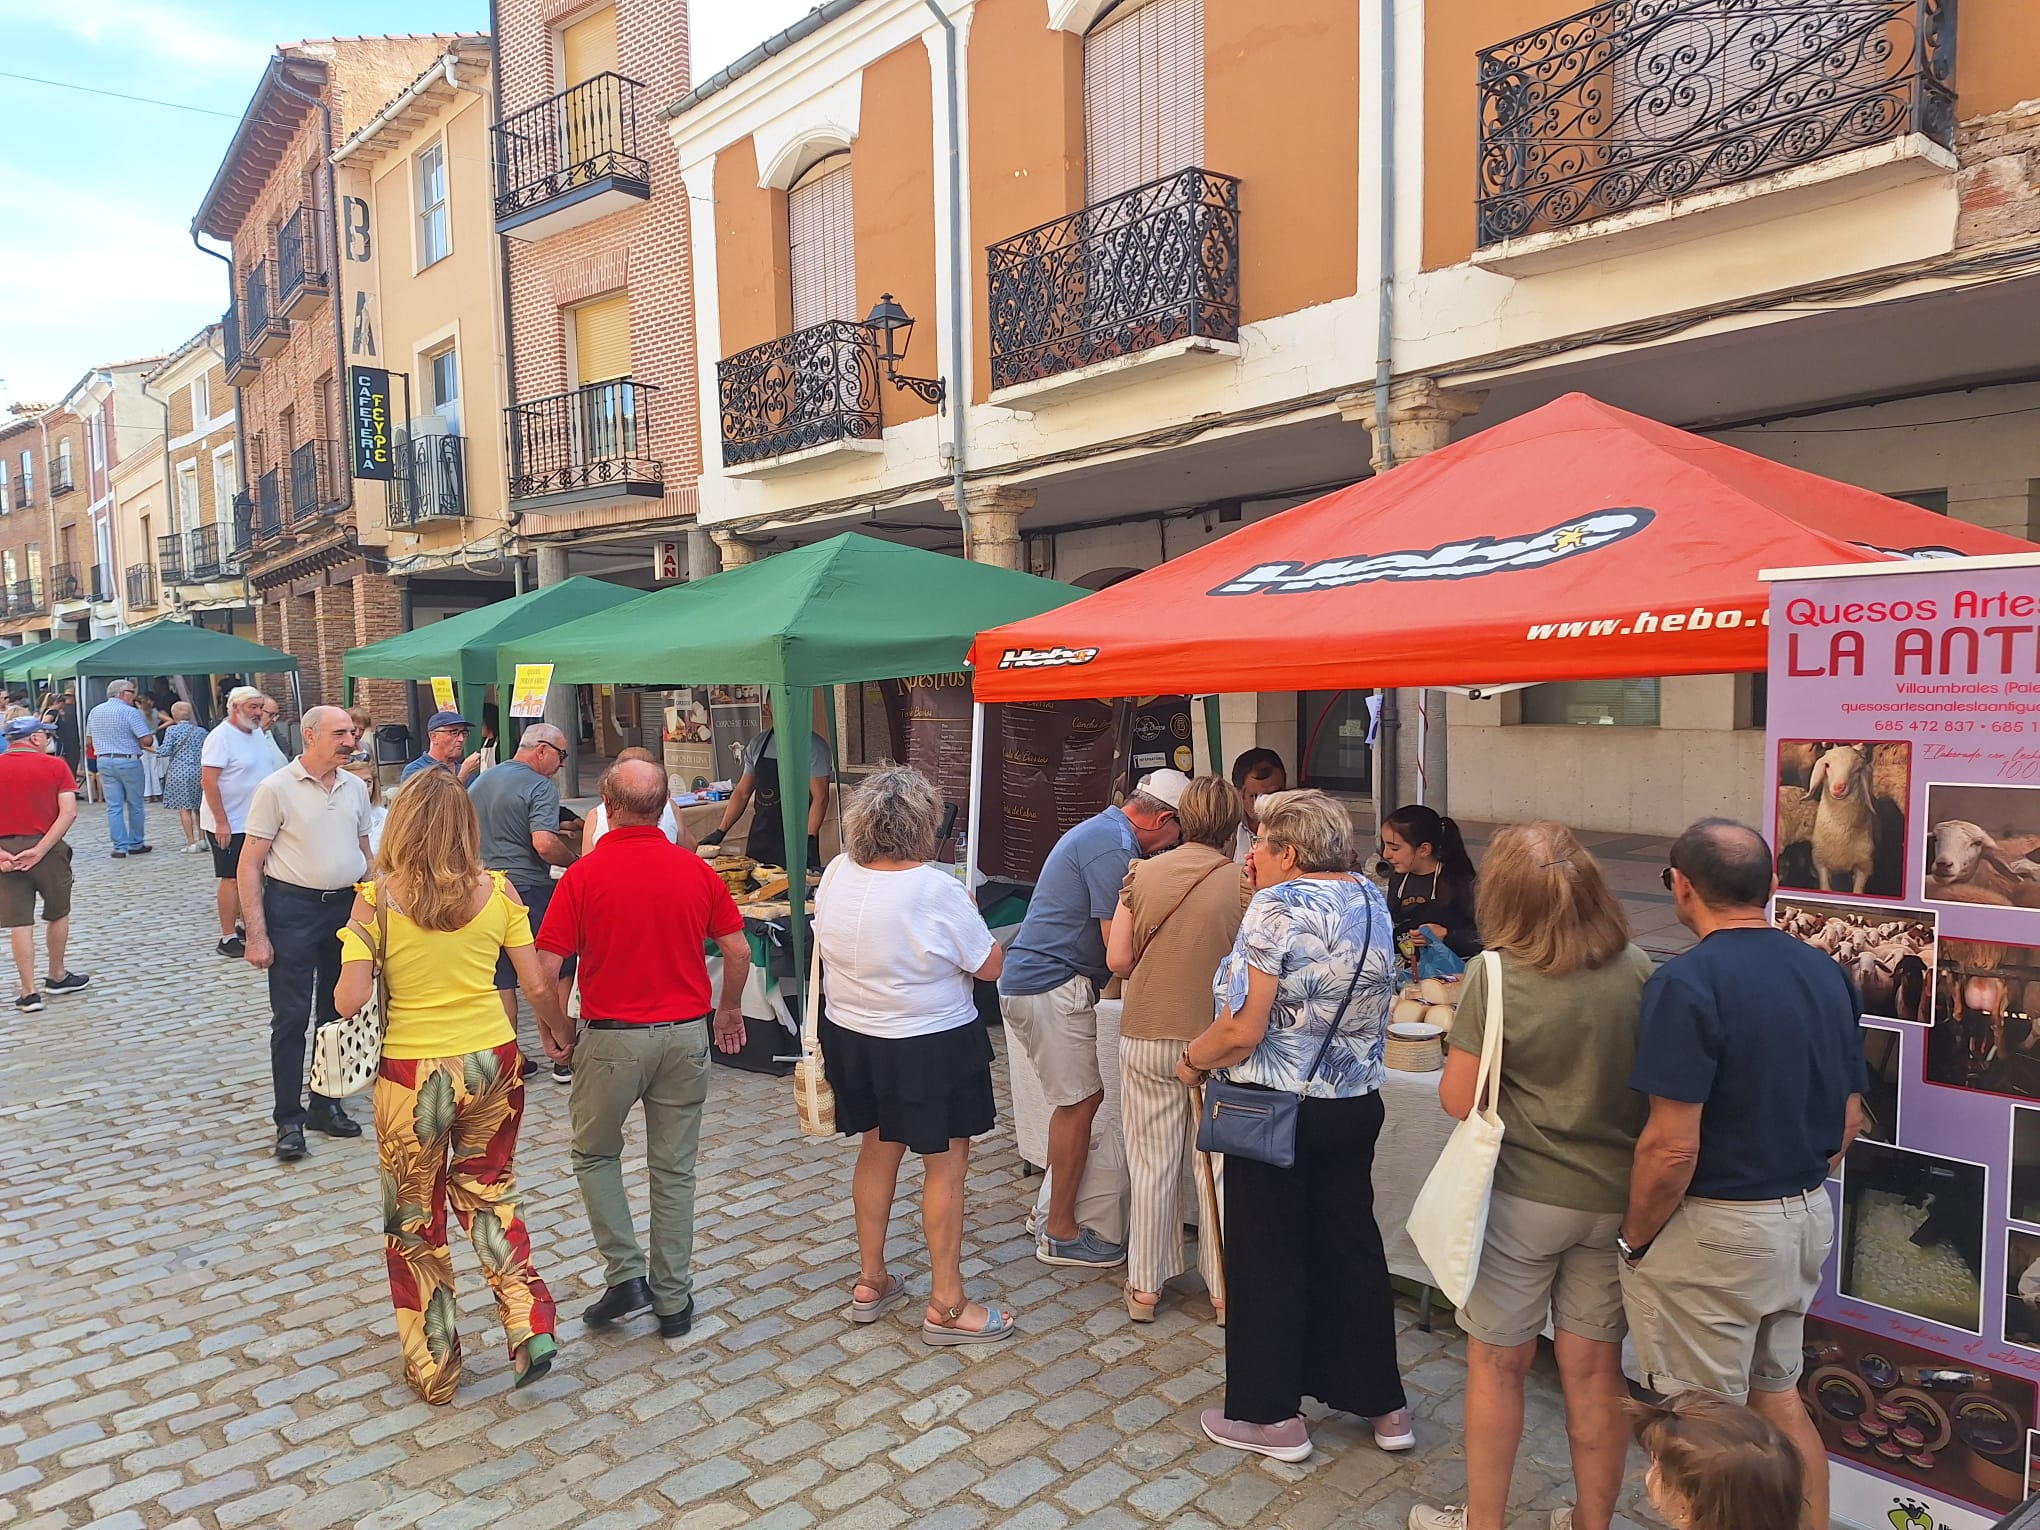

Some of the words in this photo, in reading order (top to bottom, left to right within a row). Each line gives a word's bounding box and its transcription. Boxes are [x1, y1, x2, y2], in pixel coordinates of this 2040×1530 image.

[358, 375, 375, 470] CAFETERIA
[664, 543, 676, 577] PAN
[1786, 598, 1937, 627] Quesos
[998, 647, 1099, 669] Hebo
[1788, 631, 1864, 677] LA
[1896, 682, 1999, 694] Villaumbrales
[1874, 720, 1904, 731] 685
[1909, 720, 1938, 732] 472
[1944, 721, 1975, 732] 837
[1991, 721, 2024, 732] 685
